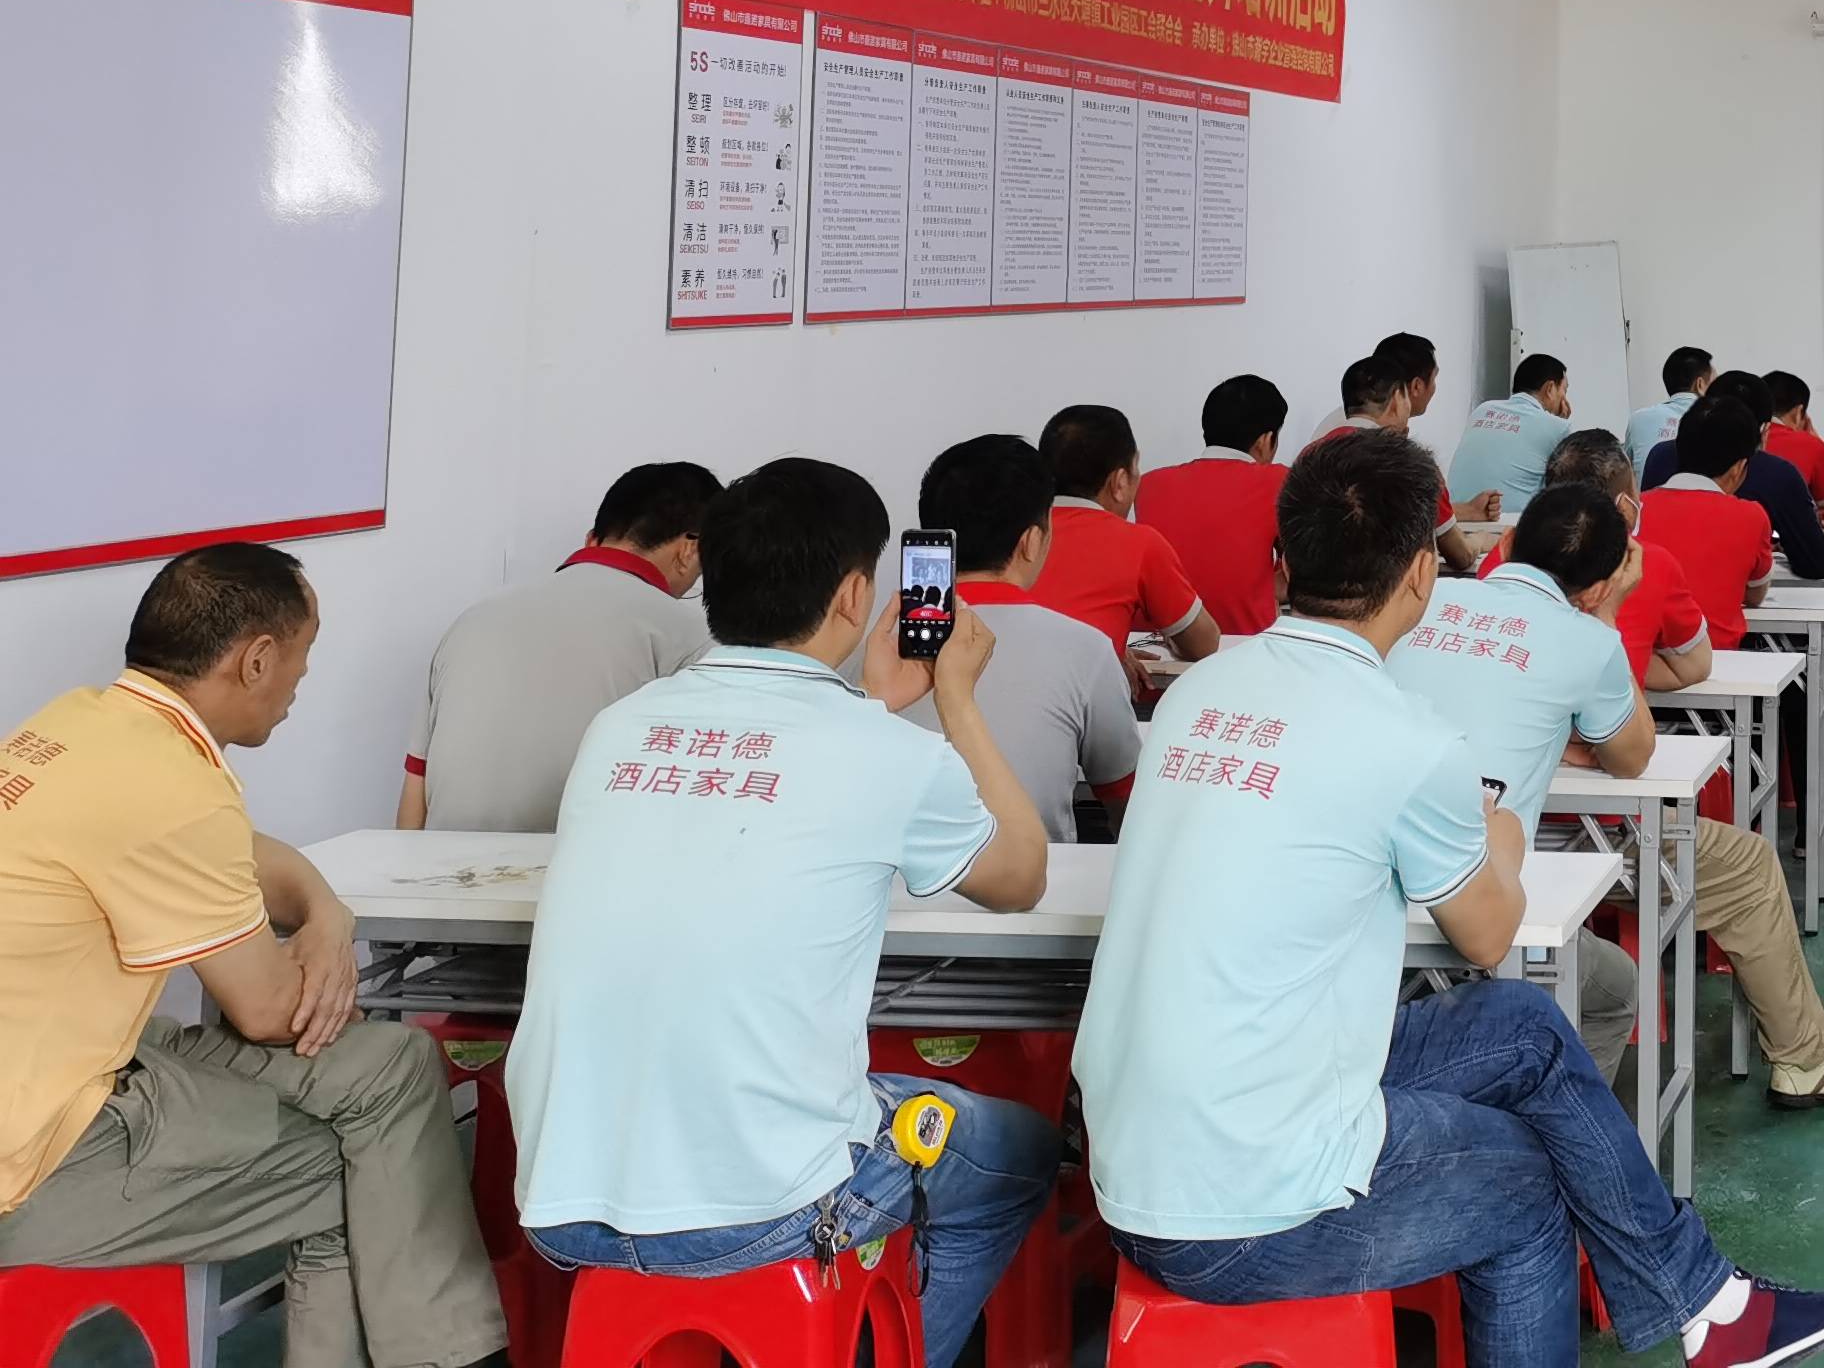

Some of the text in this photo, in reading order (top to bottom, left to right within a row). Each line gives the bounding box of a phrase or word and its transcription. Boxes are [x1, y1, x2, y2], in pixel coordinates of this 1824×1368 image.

[688, 92, 712, 111] 整理
[686, 135, 710, 155] 整顿
[686, 156, 709, 167] SEITON
[684, 179, 709, 198] 清扫
[686, 200, 705, 210] SEISO
[683, 222, 707, 241] 清洁
[681, 269, 705, 288] 素养
[677, 290, 708, 301] SHITSUKE
[1436, 603, 1530, 638] 赛诺德
[1408, 625, 1531, 672] 酒店家具
[1189, 708, 1288, 749] 赛诺德
[640, 724, 777, 760] 赛诺德
[1157, 745, 1281, 800] 酒店家具
[604, 762, 783, 803] 酒店家具
